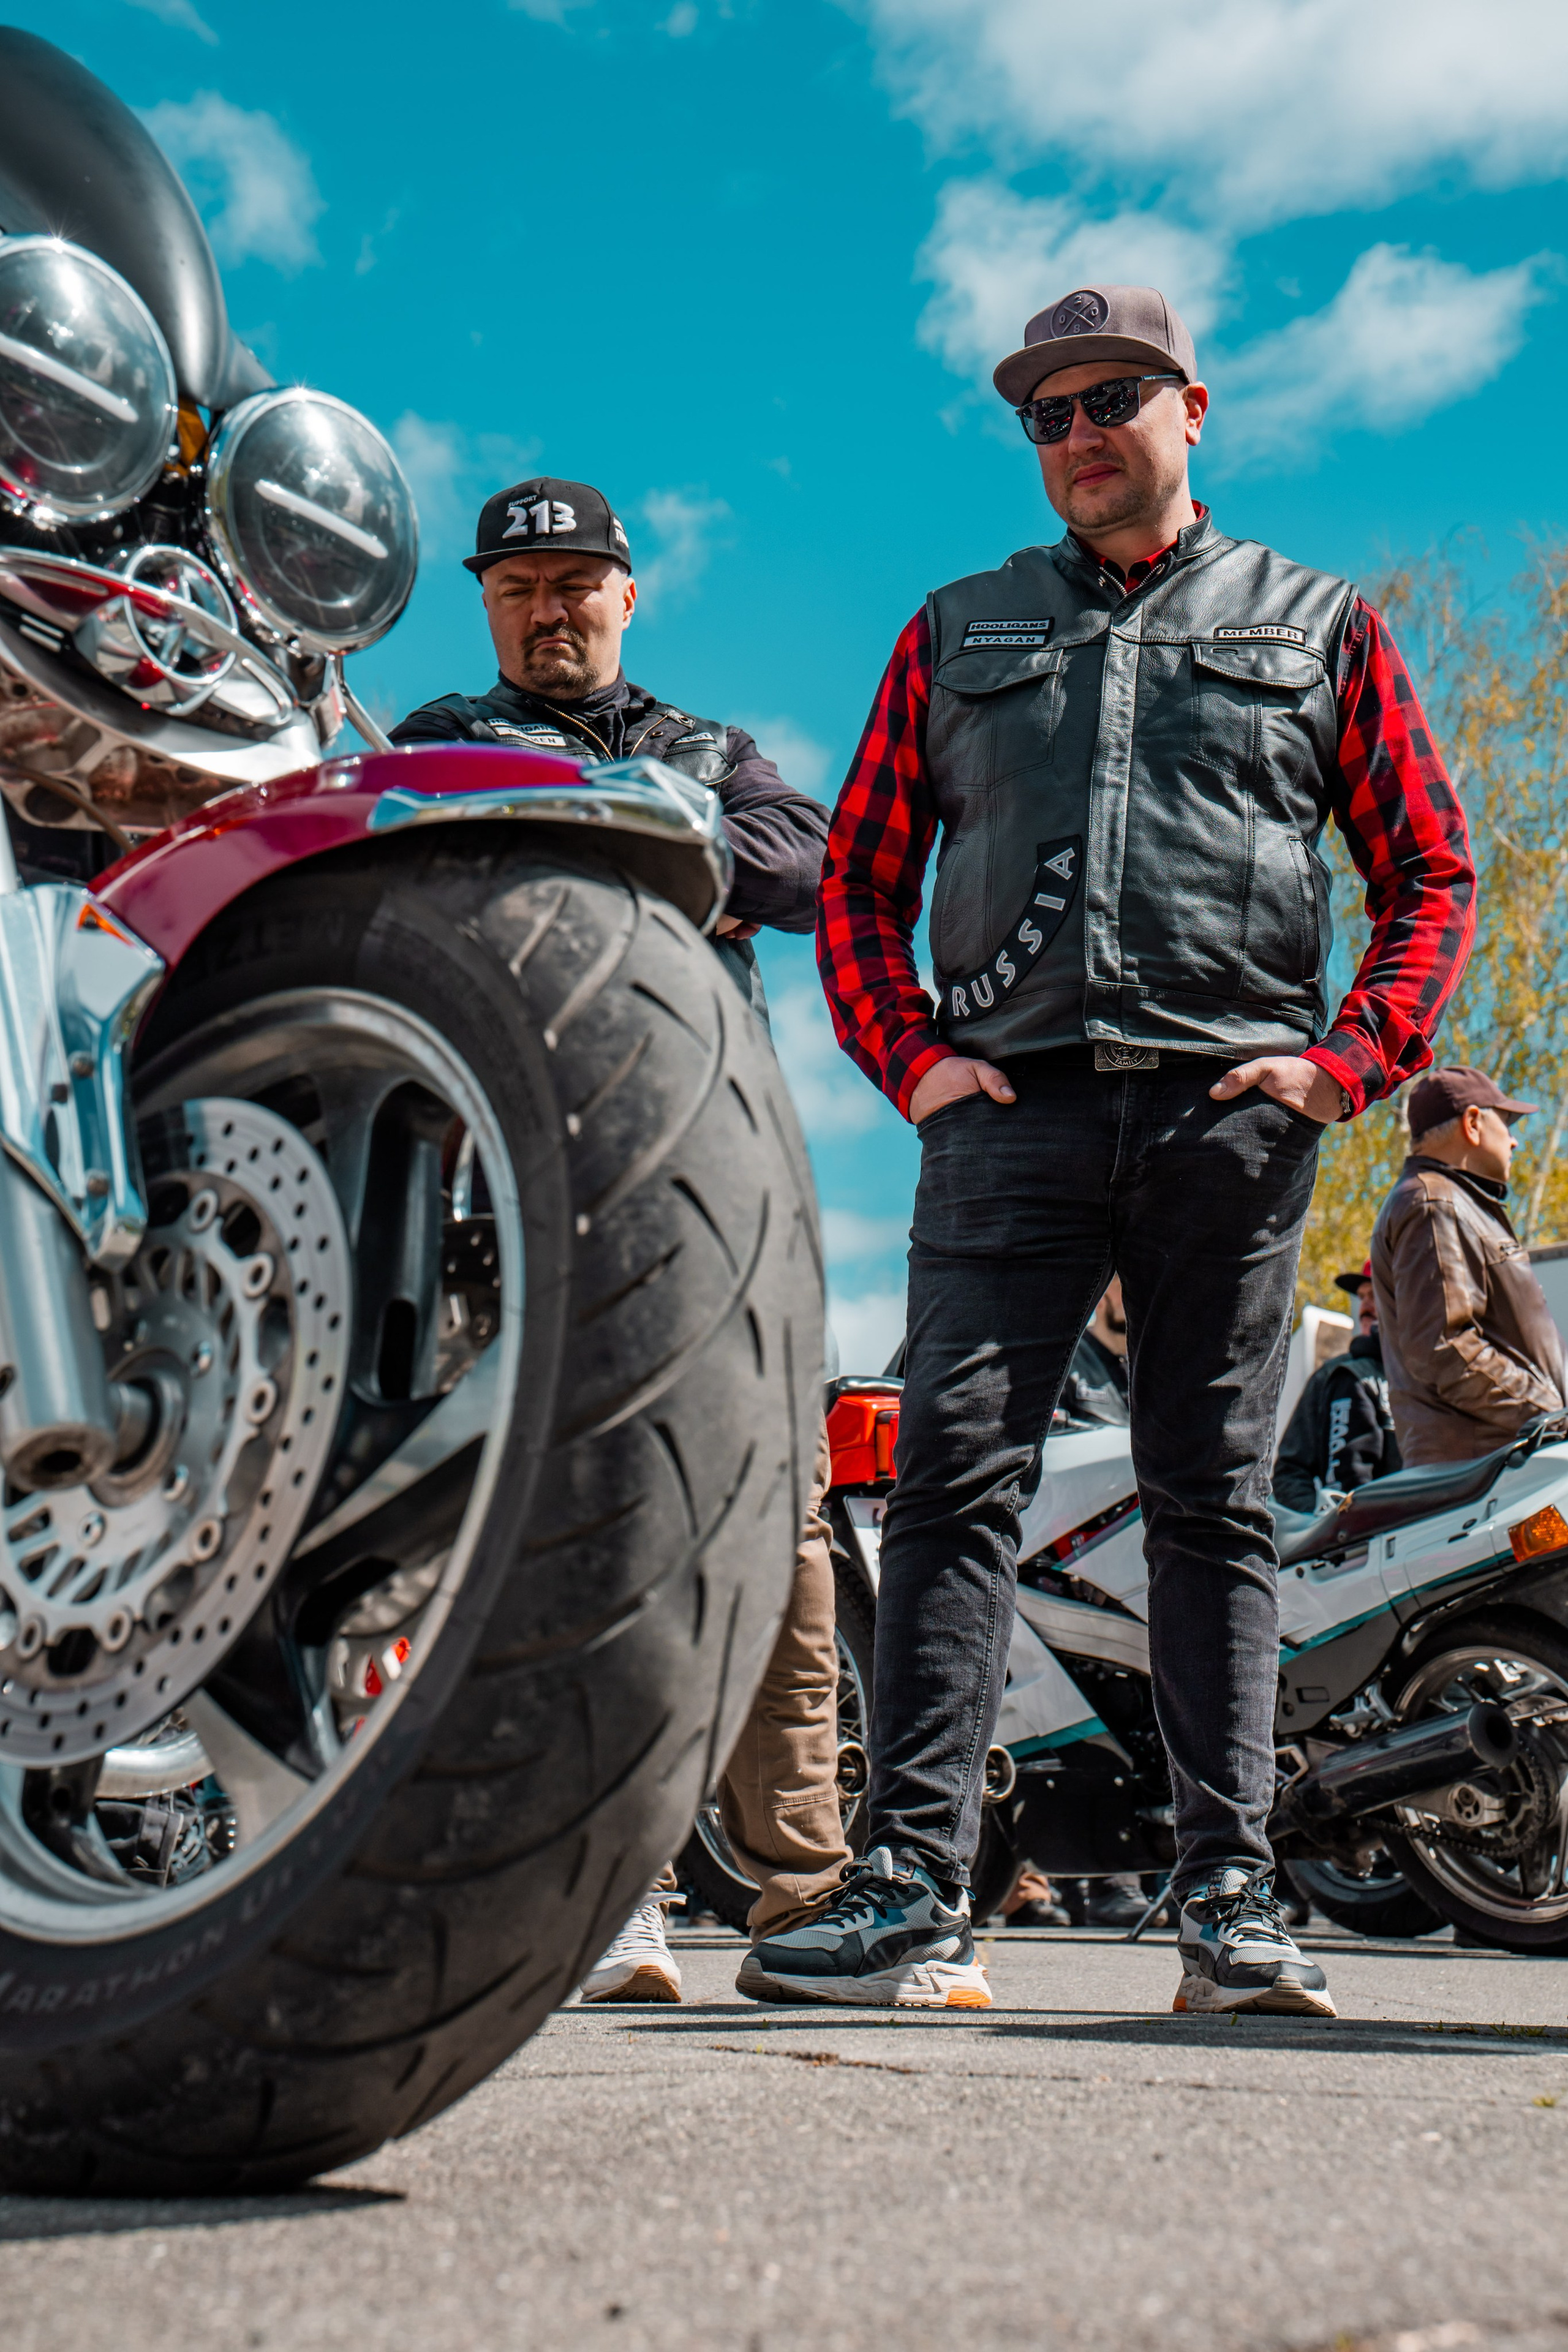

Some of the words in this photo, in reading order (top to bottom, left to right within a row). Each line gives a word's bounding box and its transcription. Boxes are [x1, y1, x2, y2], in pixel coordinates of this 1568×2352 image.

[508, 494, 538, 508] SUPPORT
[502, 499, 577, 540] 213
[971, 622, 1047, 630] HOOLIGANS
[1223, 627, 1298, 639] MEMBER
[951, 847, 1076, 1017] RUSSIA
[1115, 1058, 1138, 1066] FAMILY
